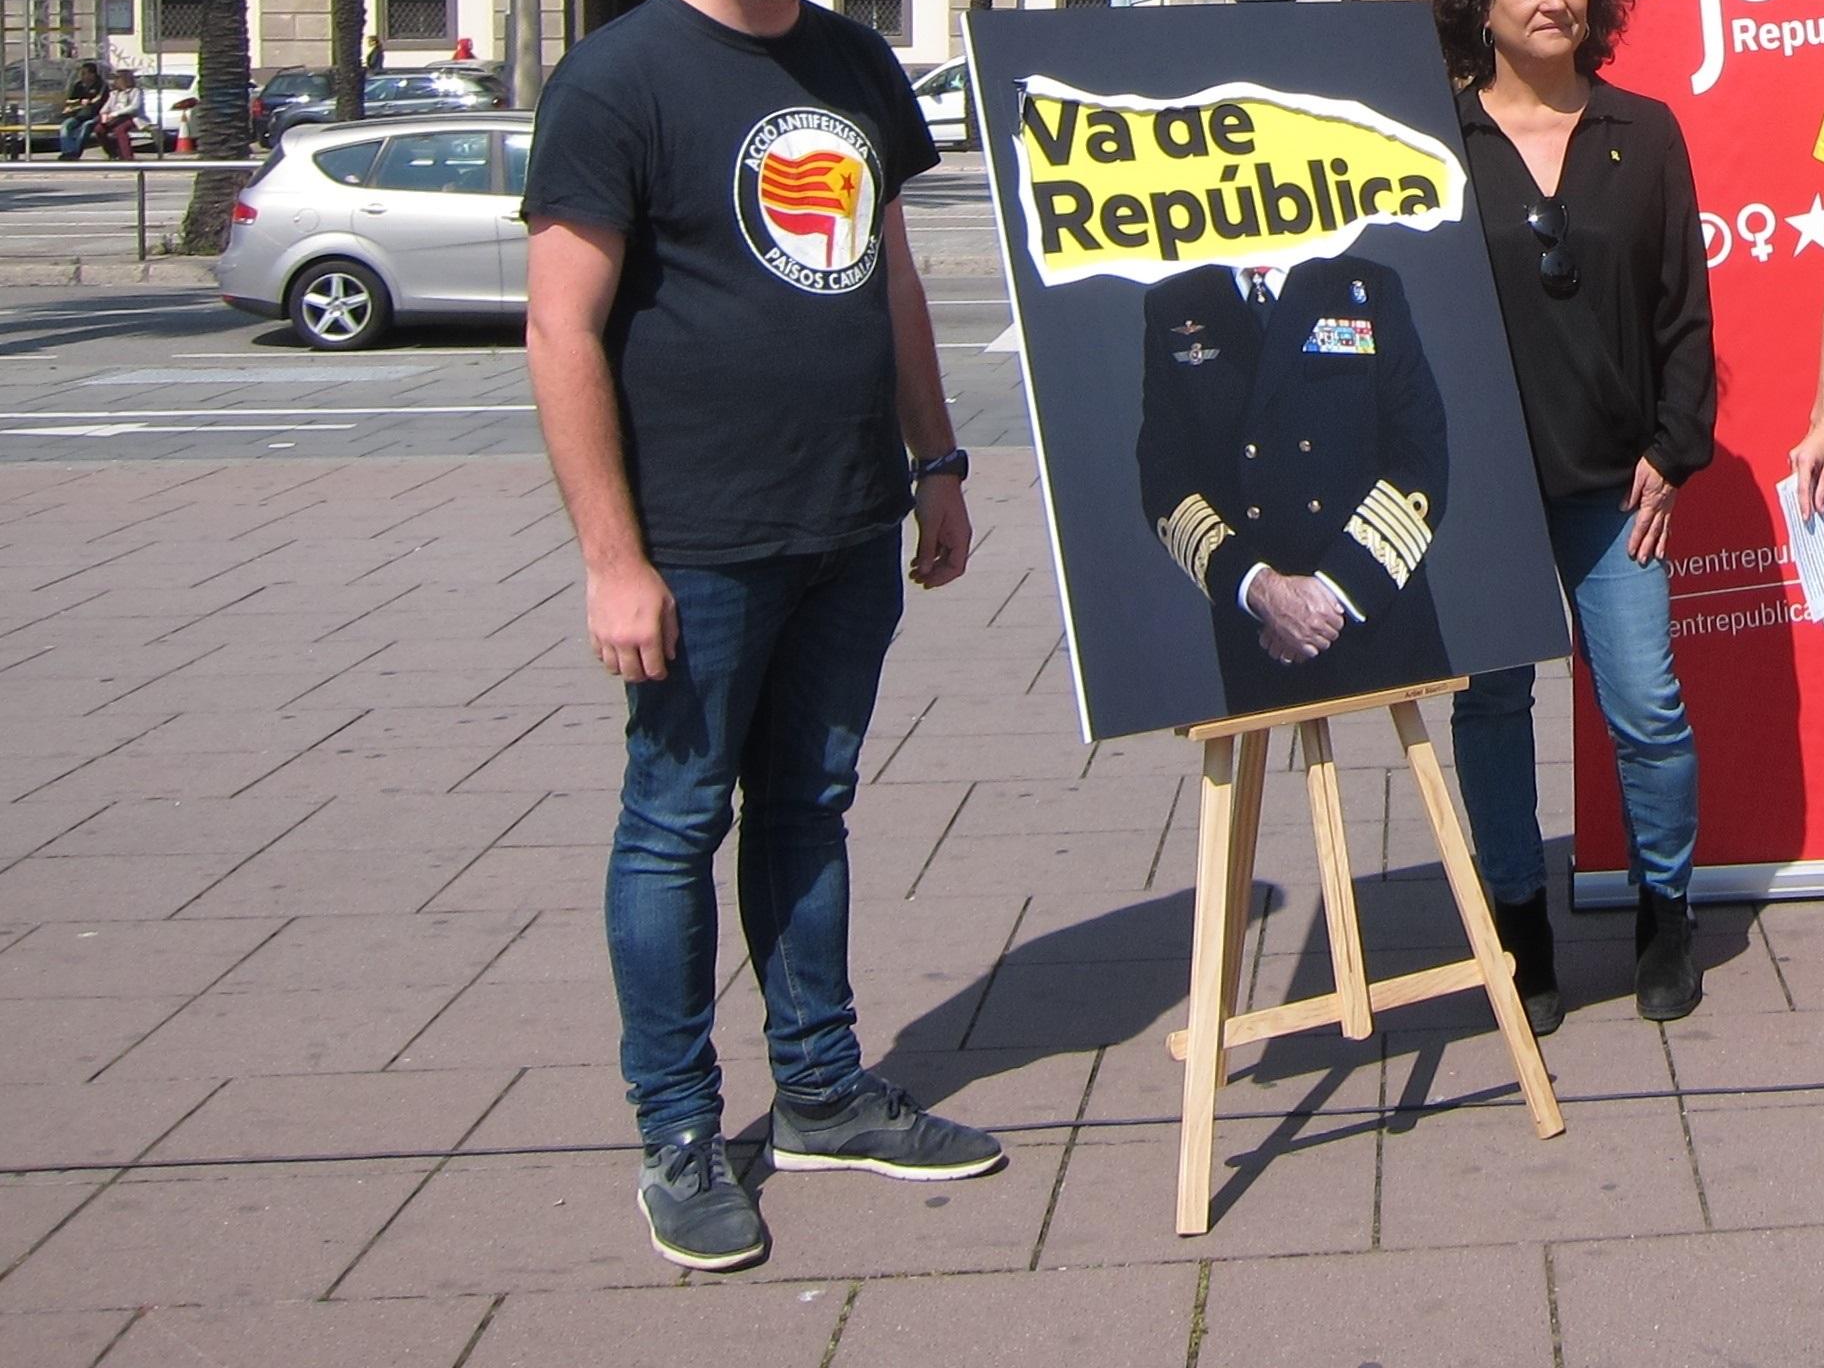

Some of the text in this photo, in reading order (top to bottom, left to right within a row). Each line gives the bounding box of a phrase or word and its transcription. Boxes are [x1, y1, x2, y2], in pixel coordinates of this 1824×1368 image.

[744, 113, 869, 172] ACCIÓ ANTIFEIXISTA
[1024, 95, 1137, 167] Va
[1032, 157, 1440, 261] República
[764, 246, 825, 289] PAÏSOS
